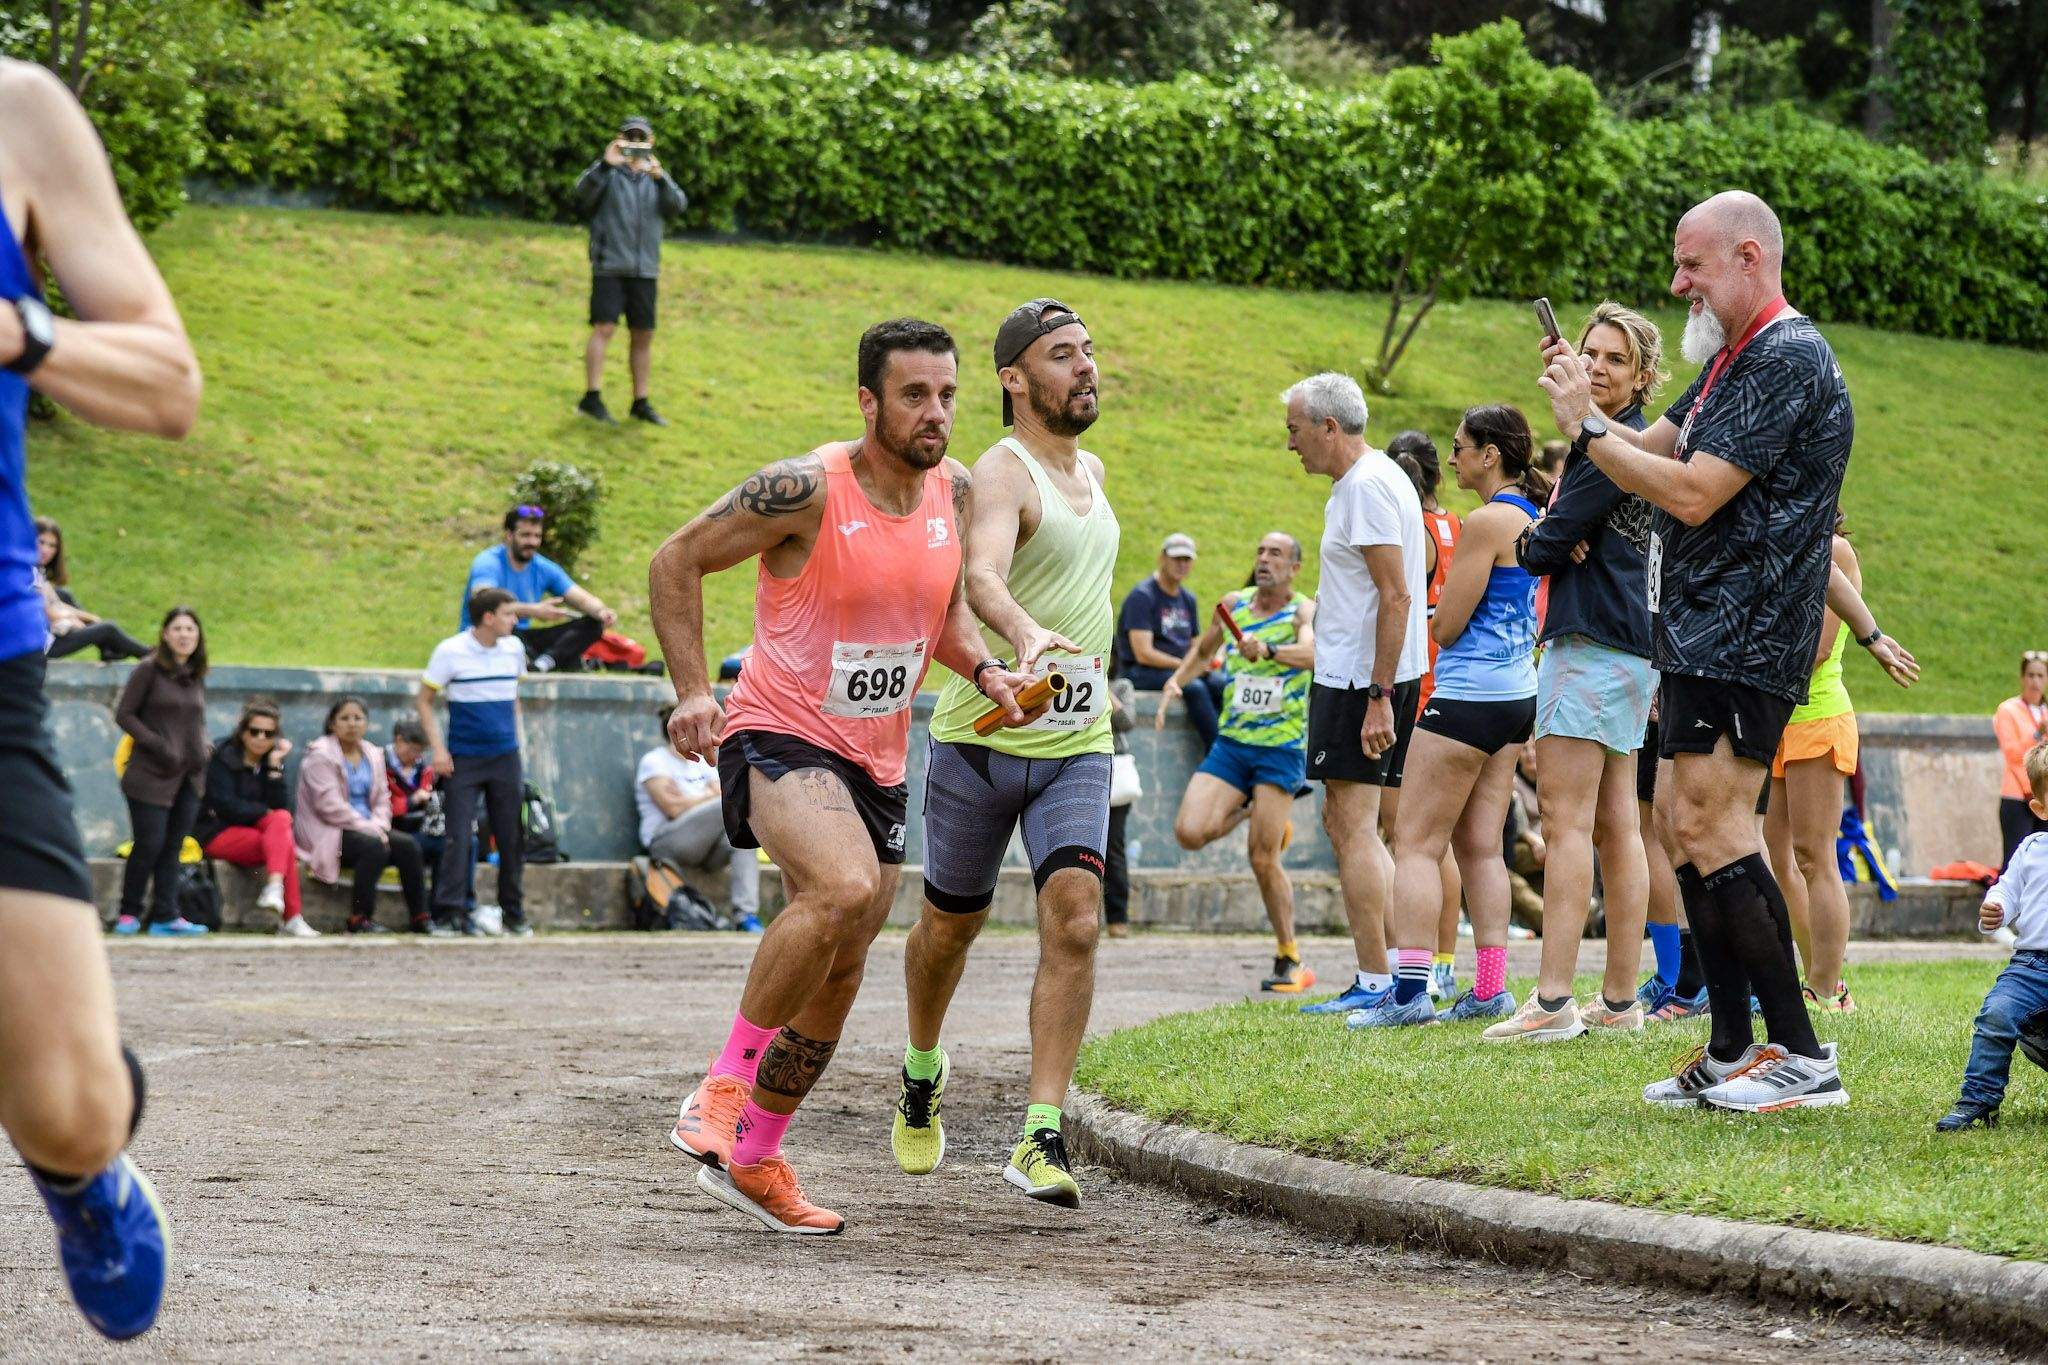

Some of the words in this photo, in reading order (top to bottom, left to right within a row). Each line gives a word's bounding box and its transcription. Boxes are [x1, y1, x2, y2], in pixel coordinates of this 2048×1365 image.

[847, 665, 907, 702] 698
[1053, 681, 1093, 713] 02
[1242, 688, 1272, 705] 807
